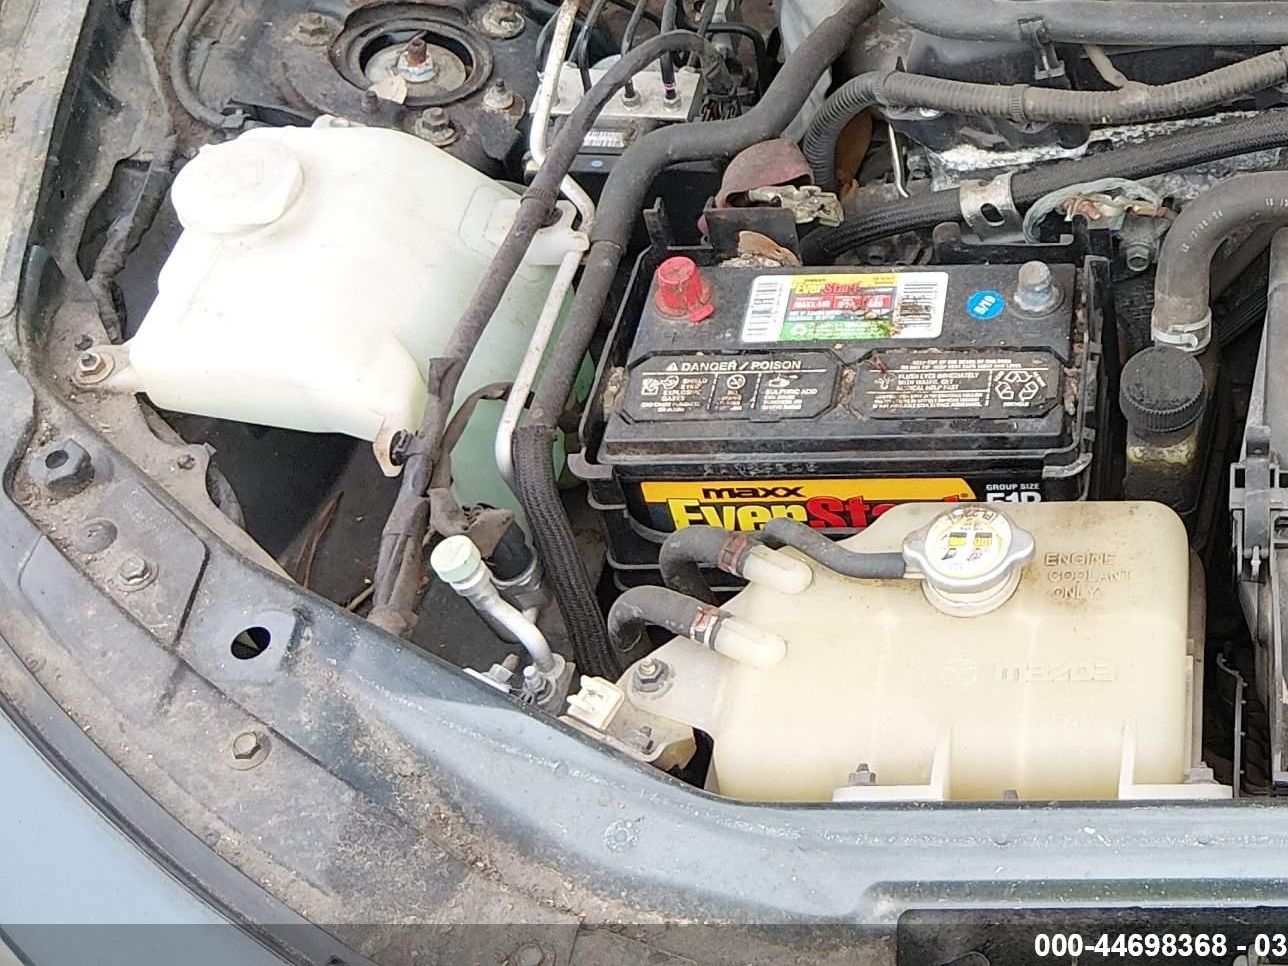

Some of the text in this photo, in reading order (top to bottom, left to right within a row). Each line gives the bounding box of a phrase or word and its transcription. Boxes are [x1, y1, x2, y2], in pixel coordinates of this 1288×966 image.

[680, 360, 802, 371] DANGER / POISON
[702, 486, 806, 499] maxx
[986, 483, 1018, 491] GROUP
[1044, 552, 1116, 567] ENGINE
[1047, 569, 1131, 583] COOLANT
[1051, 585, 1100, 600] ONLY
